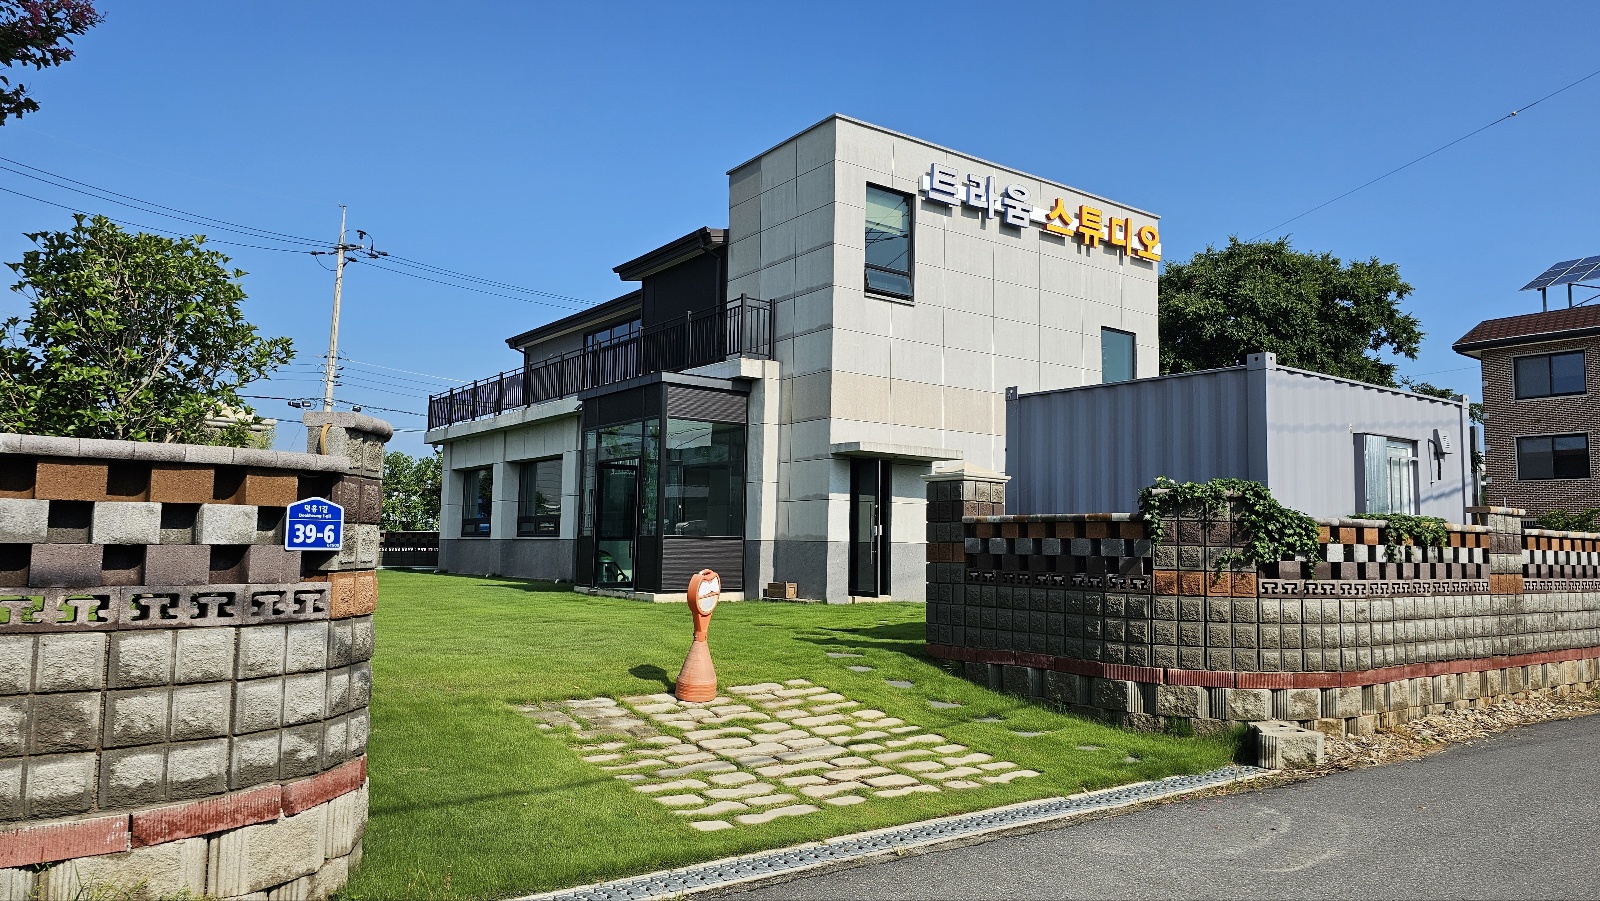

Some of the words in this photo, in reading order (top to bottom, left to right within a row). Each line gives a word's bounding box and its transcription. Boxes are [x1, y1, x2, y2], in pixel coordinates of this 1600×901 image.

[925, 162, 1033, 229] 트라움
[1044, 197, 1161, 262] 스튜디오
[293, 524, 335, 544] 39-6
